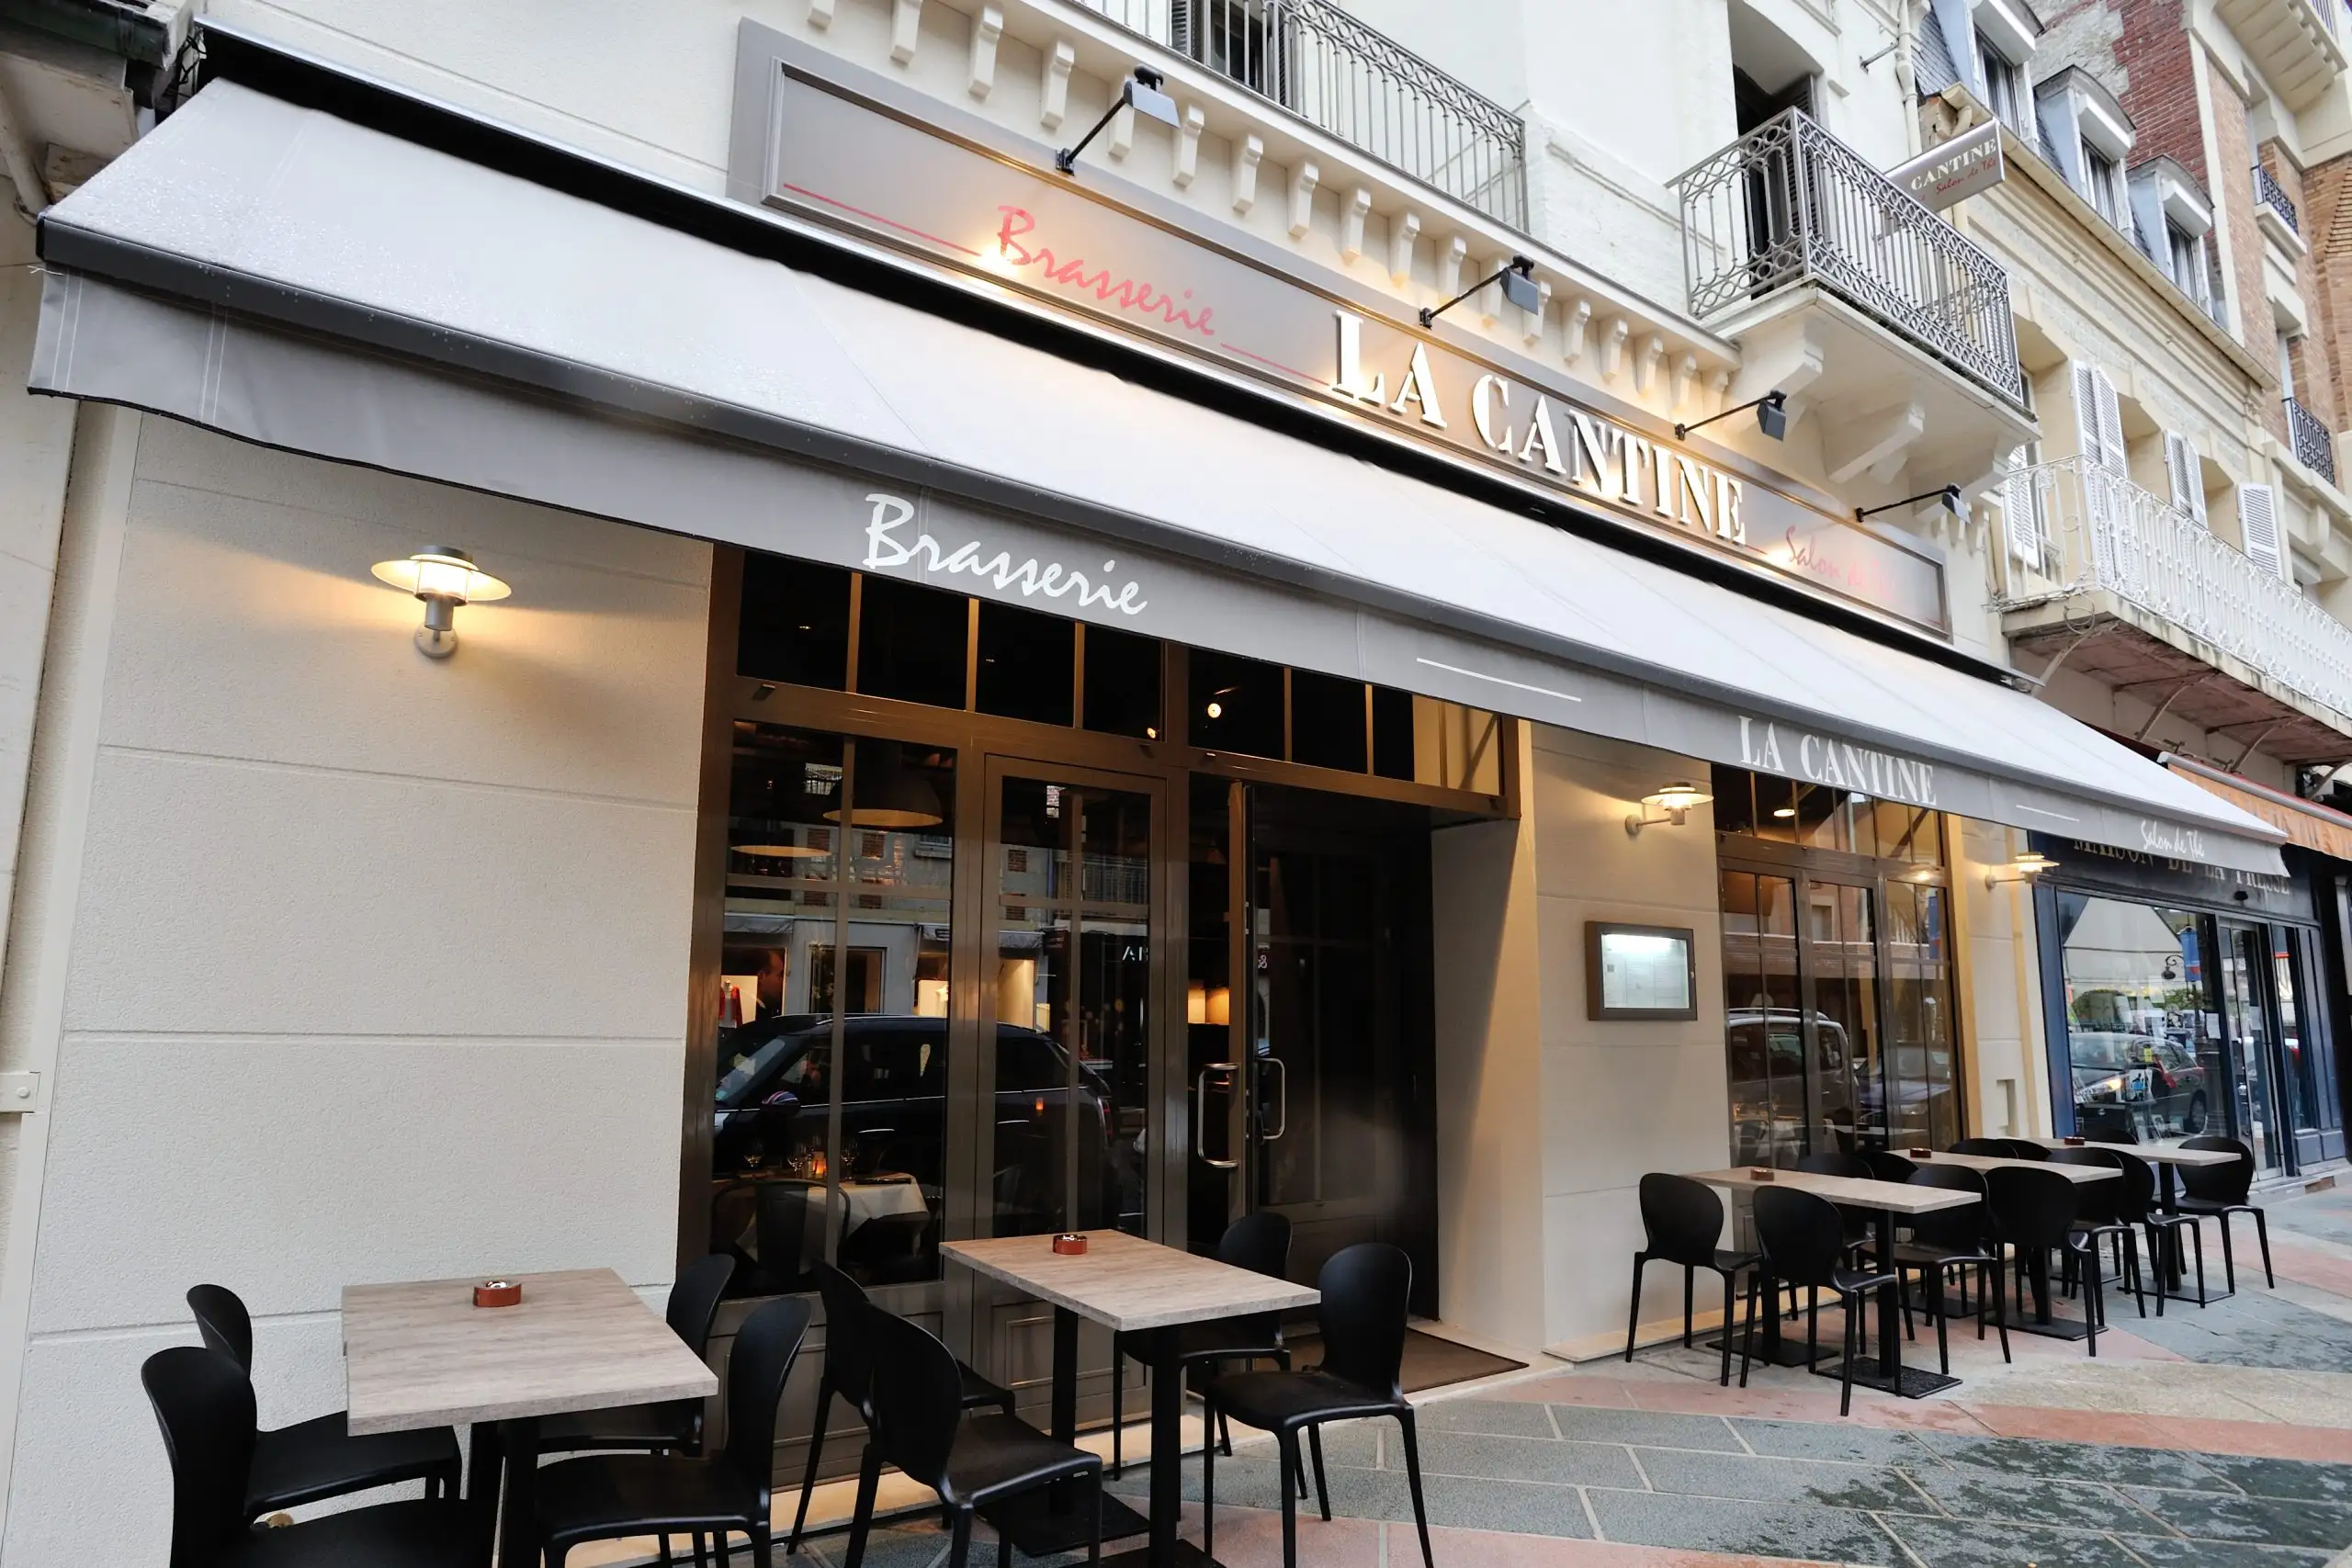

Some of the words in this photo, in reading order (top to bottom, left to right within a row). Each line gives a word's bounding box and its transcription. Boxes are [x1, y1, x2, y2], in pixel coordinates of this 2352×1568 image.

[1910, 137, 1997, 191] CANTINE
[996, 205, 1216, 337] Brasserie
[1329, 309, 1449, 431] LA
[1470, 372, 1747, 547] CANTINE
[862, 492, 1149, 615] Brasserie
[1785, 524, 1841, 579] Salon
[1737, 715, 1786, 773] LA
[1800, 734, 1937, 807] CANTINE
[2140, 818, 2173, 852] Salon
